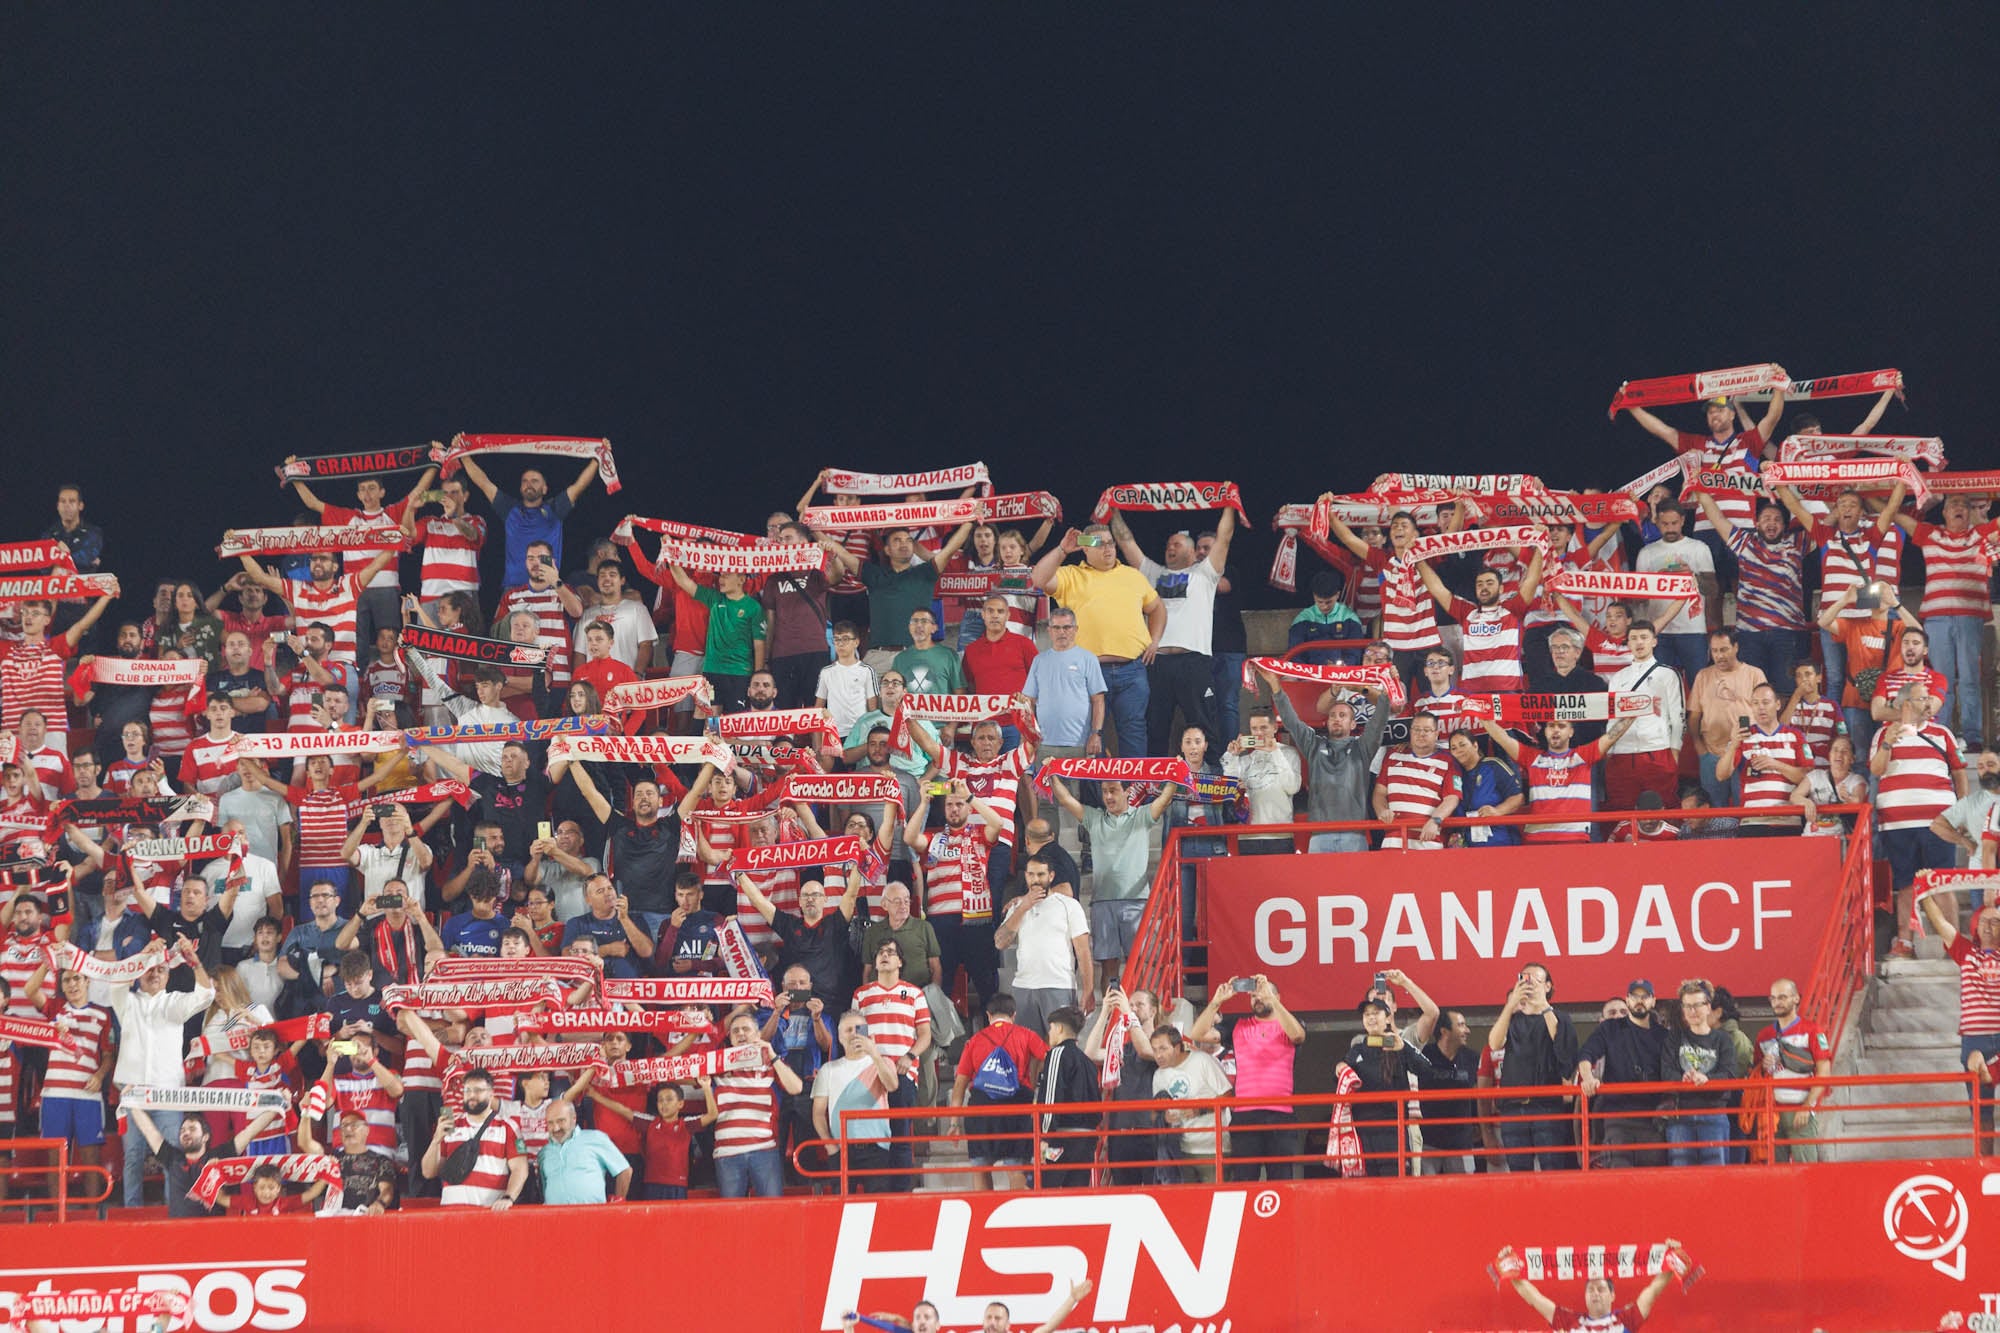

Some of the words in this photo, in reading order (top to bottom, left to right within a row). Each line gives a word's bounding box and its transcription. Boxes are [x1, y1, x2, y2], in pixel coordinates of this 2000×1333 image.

[1113, 488, 1196, 504] GRANADA
[1495, 503, 1576, 517] GRANADA
[661, 520, 687, 536] CLUB
[1410, 527, 1511, 556] RANADA
[685, 551, 700, 563] YO
[704, 553, 726, 566] SOY
[728, 555, 749, 567] DEL
[940, 575, 988, 590] GRANADA
[1564, 574, 1649, 592] GRANADA
[131, 663, 176, 671] GRANADA
[115, 673, 140, 683] CLUB
[143, 674, 154, 683] DE
[903, 694, 982, 713] RANADA
[1520, 695, 1587, 709] GRANADA
[1522, 711, 1542, 721] CLUB
[577, 740, 664, 755] GRANADA
[671, 743, 695, 755] CF
[1061, 758, 1144, 776] GRANADA
[789, 781, 834, 797] Granada
[836, 779, 855, 798] Club
[858, 781, 871, 797] de
[747, 841, 828, 869] GRANADA
[418, 985, 460, 1008] Granada
[464, 984, 485, 1003] Club
[4, 1021, 54, 1038] PRIMERA
[467, 1050, 511, 1073] Granada
[515, 1049, 536, 1067] Club
[820, 1191, 1247, 1331] HSN
[1564, 1252, 1596, 1268] NEVER
[32, 1294, 114, 1316] GRANADA
[119, 1293, 143, 1312] CF
